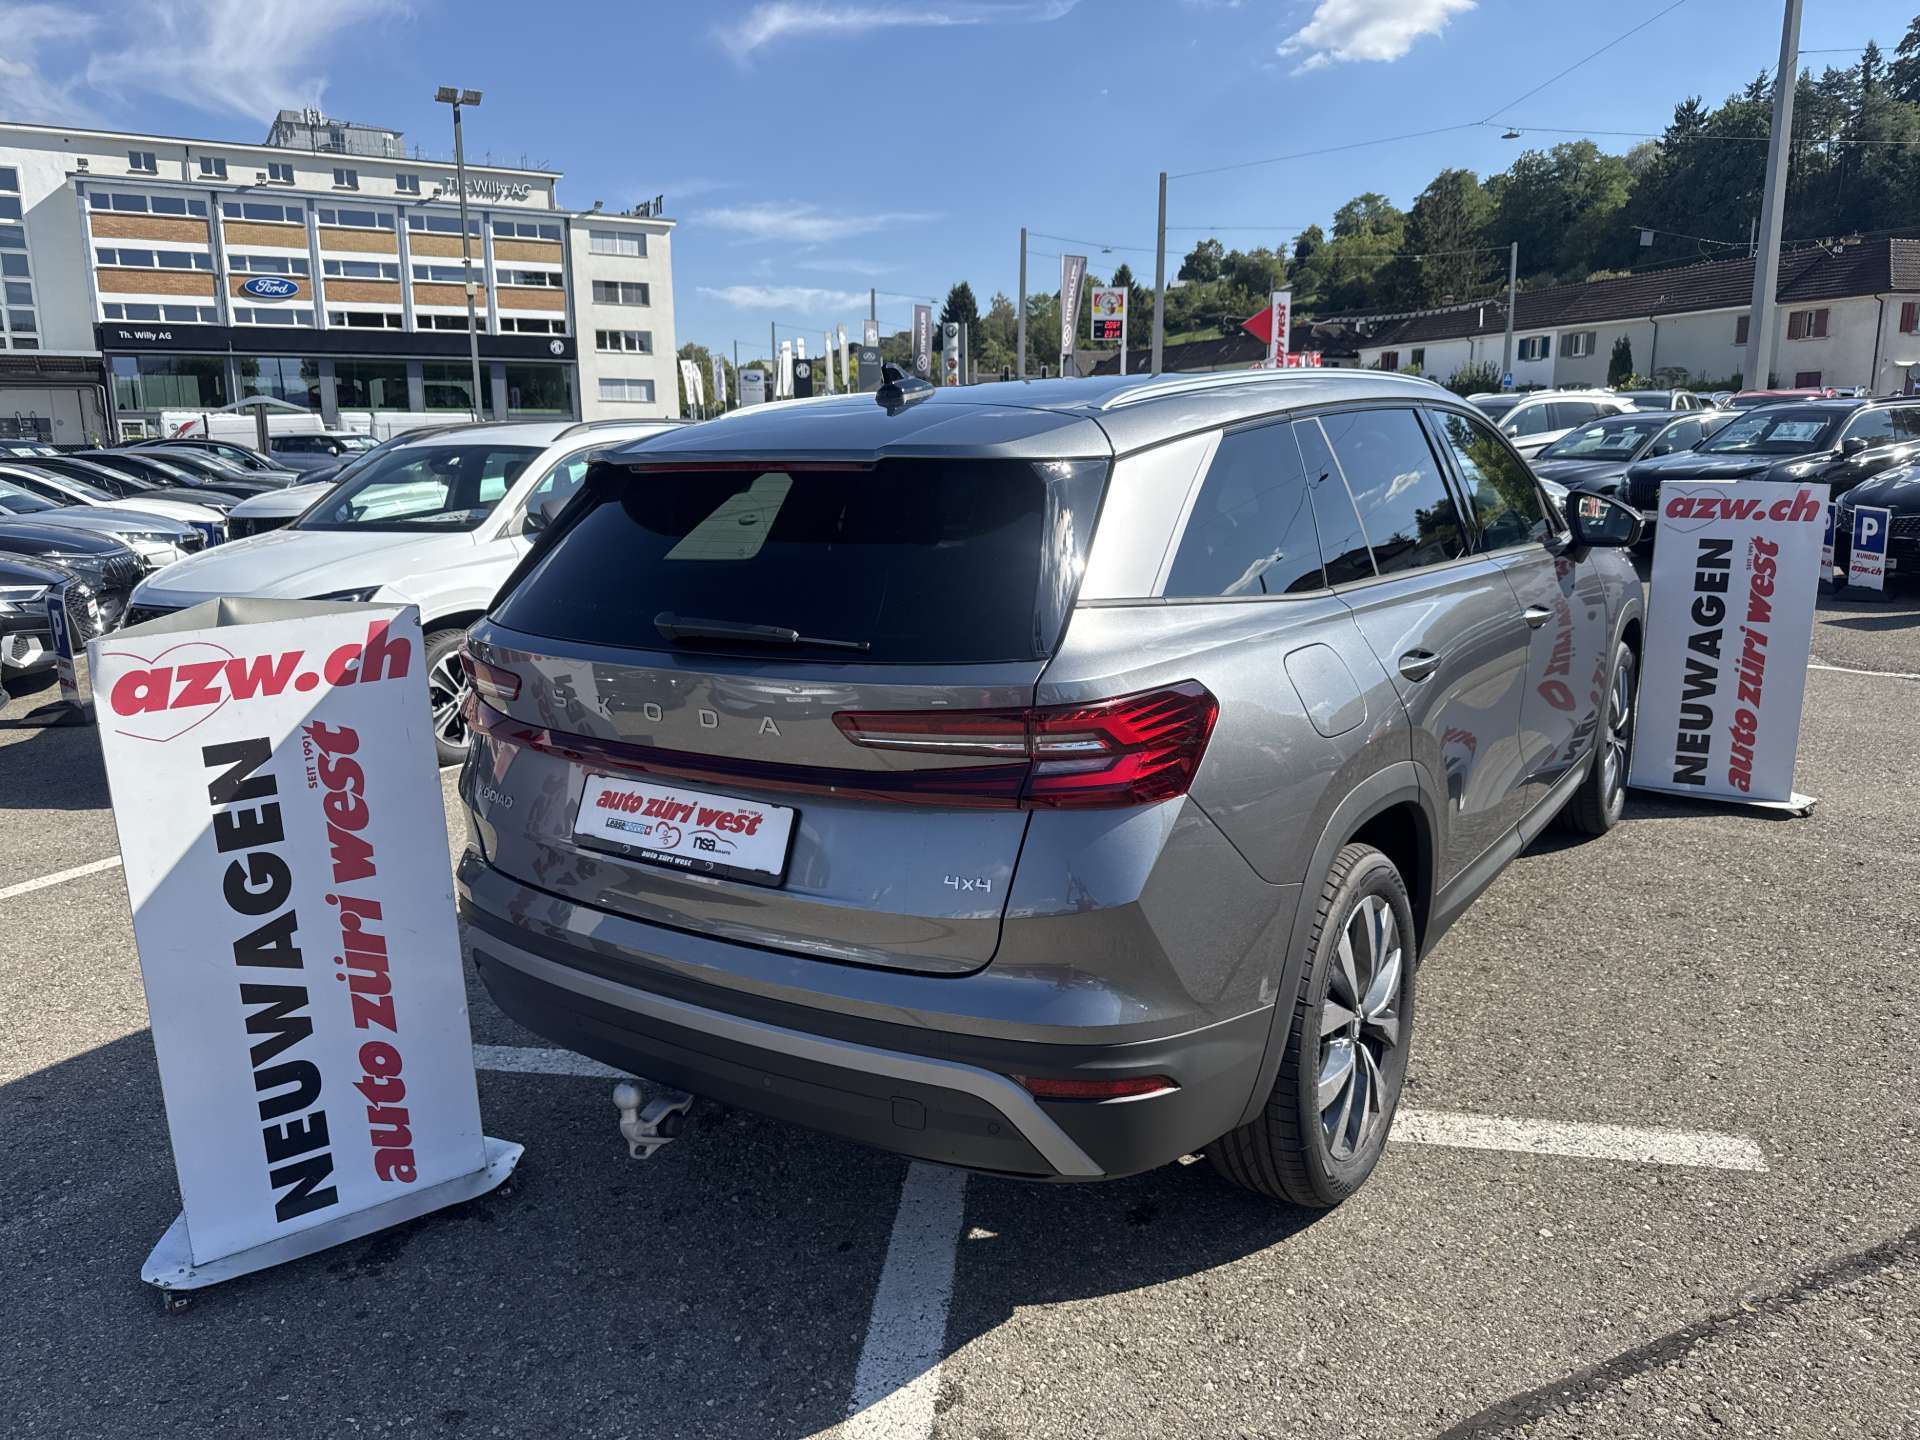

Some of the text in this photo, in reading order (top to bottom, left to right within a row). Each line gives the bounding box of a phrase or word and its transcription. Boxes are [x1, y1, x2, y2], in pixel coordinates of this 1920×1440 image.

[473, 178, 507, 198] Willy
[511, 183, 532, 196] AG
[255, 279, 289, 294] Ford
[118, 330, 172, 341] Th. Willy AG
[1664, 489, 1821, 522] azw.ch
[1860, 516, 1879, 545] P
[1851, 565, 1883, 576] azw.ch
[1855, 552, 1880, 561] KUNDEN
[51, 609, 63, 649] P
[110, 619, 412, 717] azw.ch
[1672, 538, 1734, 786] NEUWAGEN
[1728, 535, 1779, 793] auto züri west
[301, 735, 318, 789] SEIT 1991
[595, 789, 763, 836] auto züri west
[641, 850, 658, 859] auto
[674, 857, 692, 867] west
[693, 836, 716, 852] nsa
[944, 875, 991, 892] 4x4
[300, 720, 419, 1184] auto züri west
[202, 735, 340, 1223] NEUWAGEN
